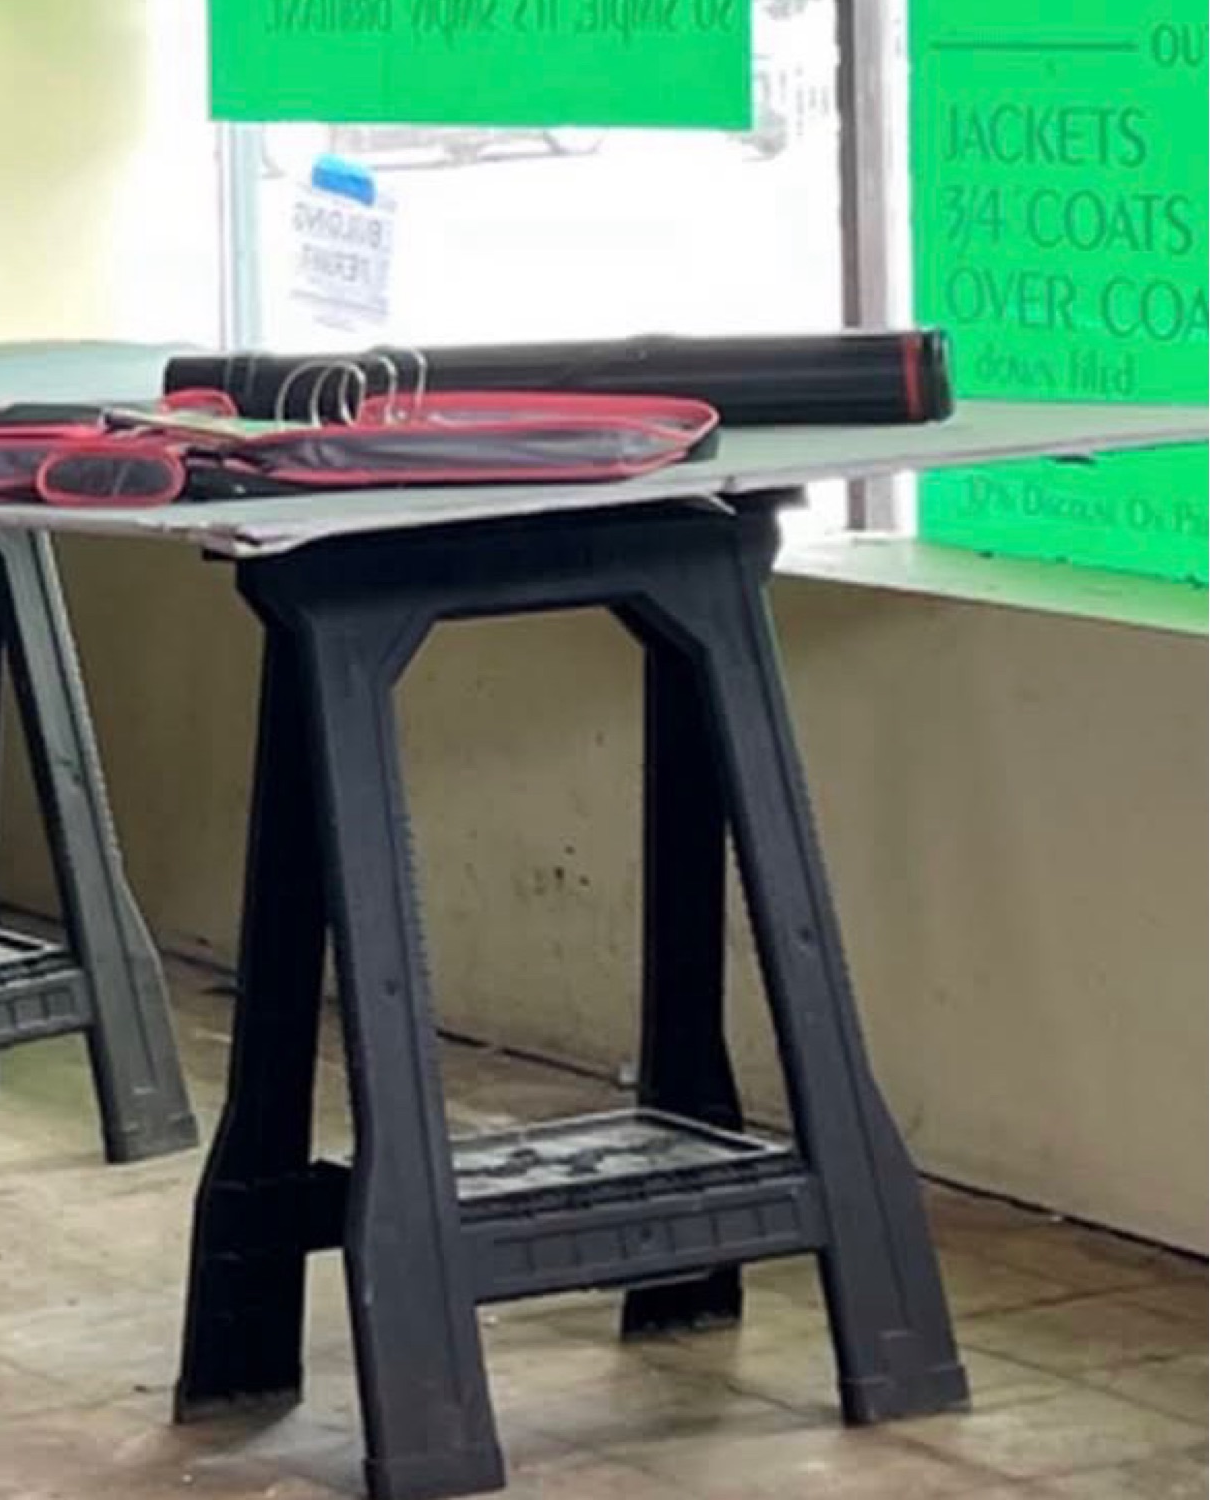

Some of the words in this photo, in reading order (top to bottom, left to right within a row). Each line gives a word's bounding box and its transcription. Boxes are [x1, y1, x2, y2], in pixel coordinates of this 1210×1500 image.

[1151, 21, 1209, 69] OU
[942, 102, 1147, 168] JACKETS
[1026, 188, 1194, 256] COATS
[946, 266, 1076, 333] OVER
